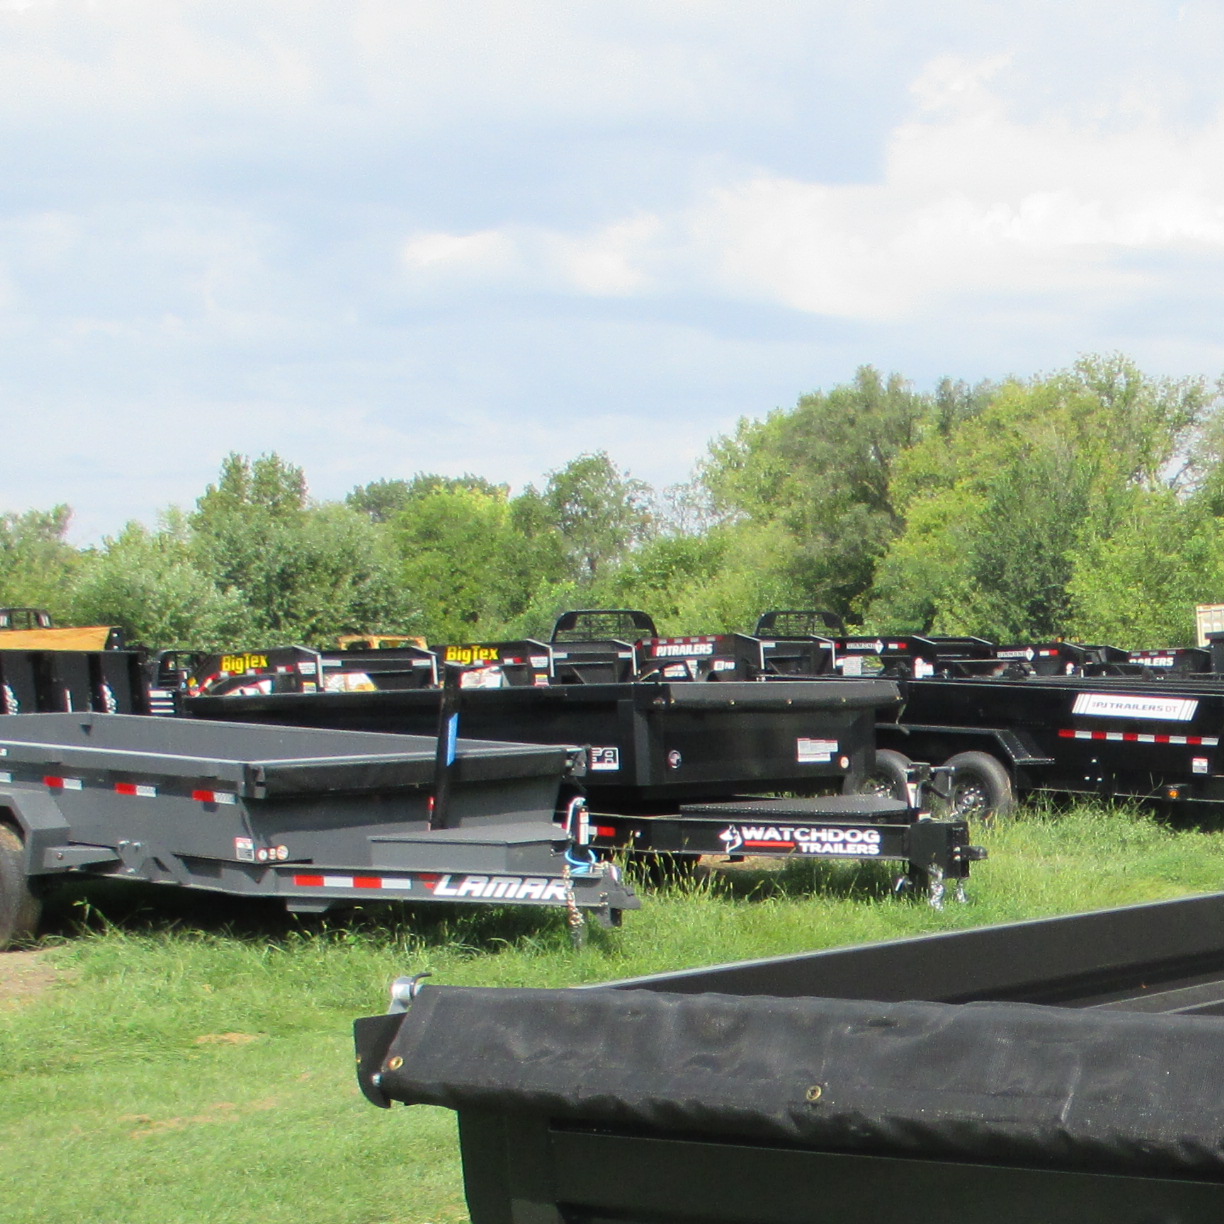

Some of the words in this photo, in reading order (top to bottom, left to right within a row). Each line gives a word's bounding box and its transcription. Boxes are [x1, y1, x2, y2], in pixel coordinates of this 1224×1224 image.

[656, 645, 667, 657] PJ
[667, 643, 713, 656] TRAILERS
[1128, 657, 1174, 667] RAILERS
[1109, 702, 1163, 712] TRAILERS
[1165, 704, 1179, 713] DT
[741, 826, 881, 843] WATCHDOG
[799, 842, 880, 855] TRAILERS
[433, 874, 574, 901] LAMAR
